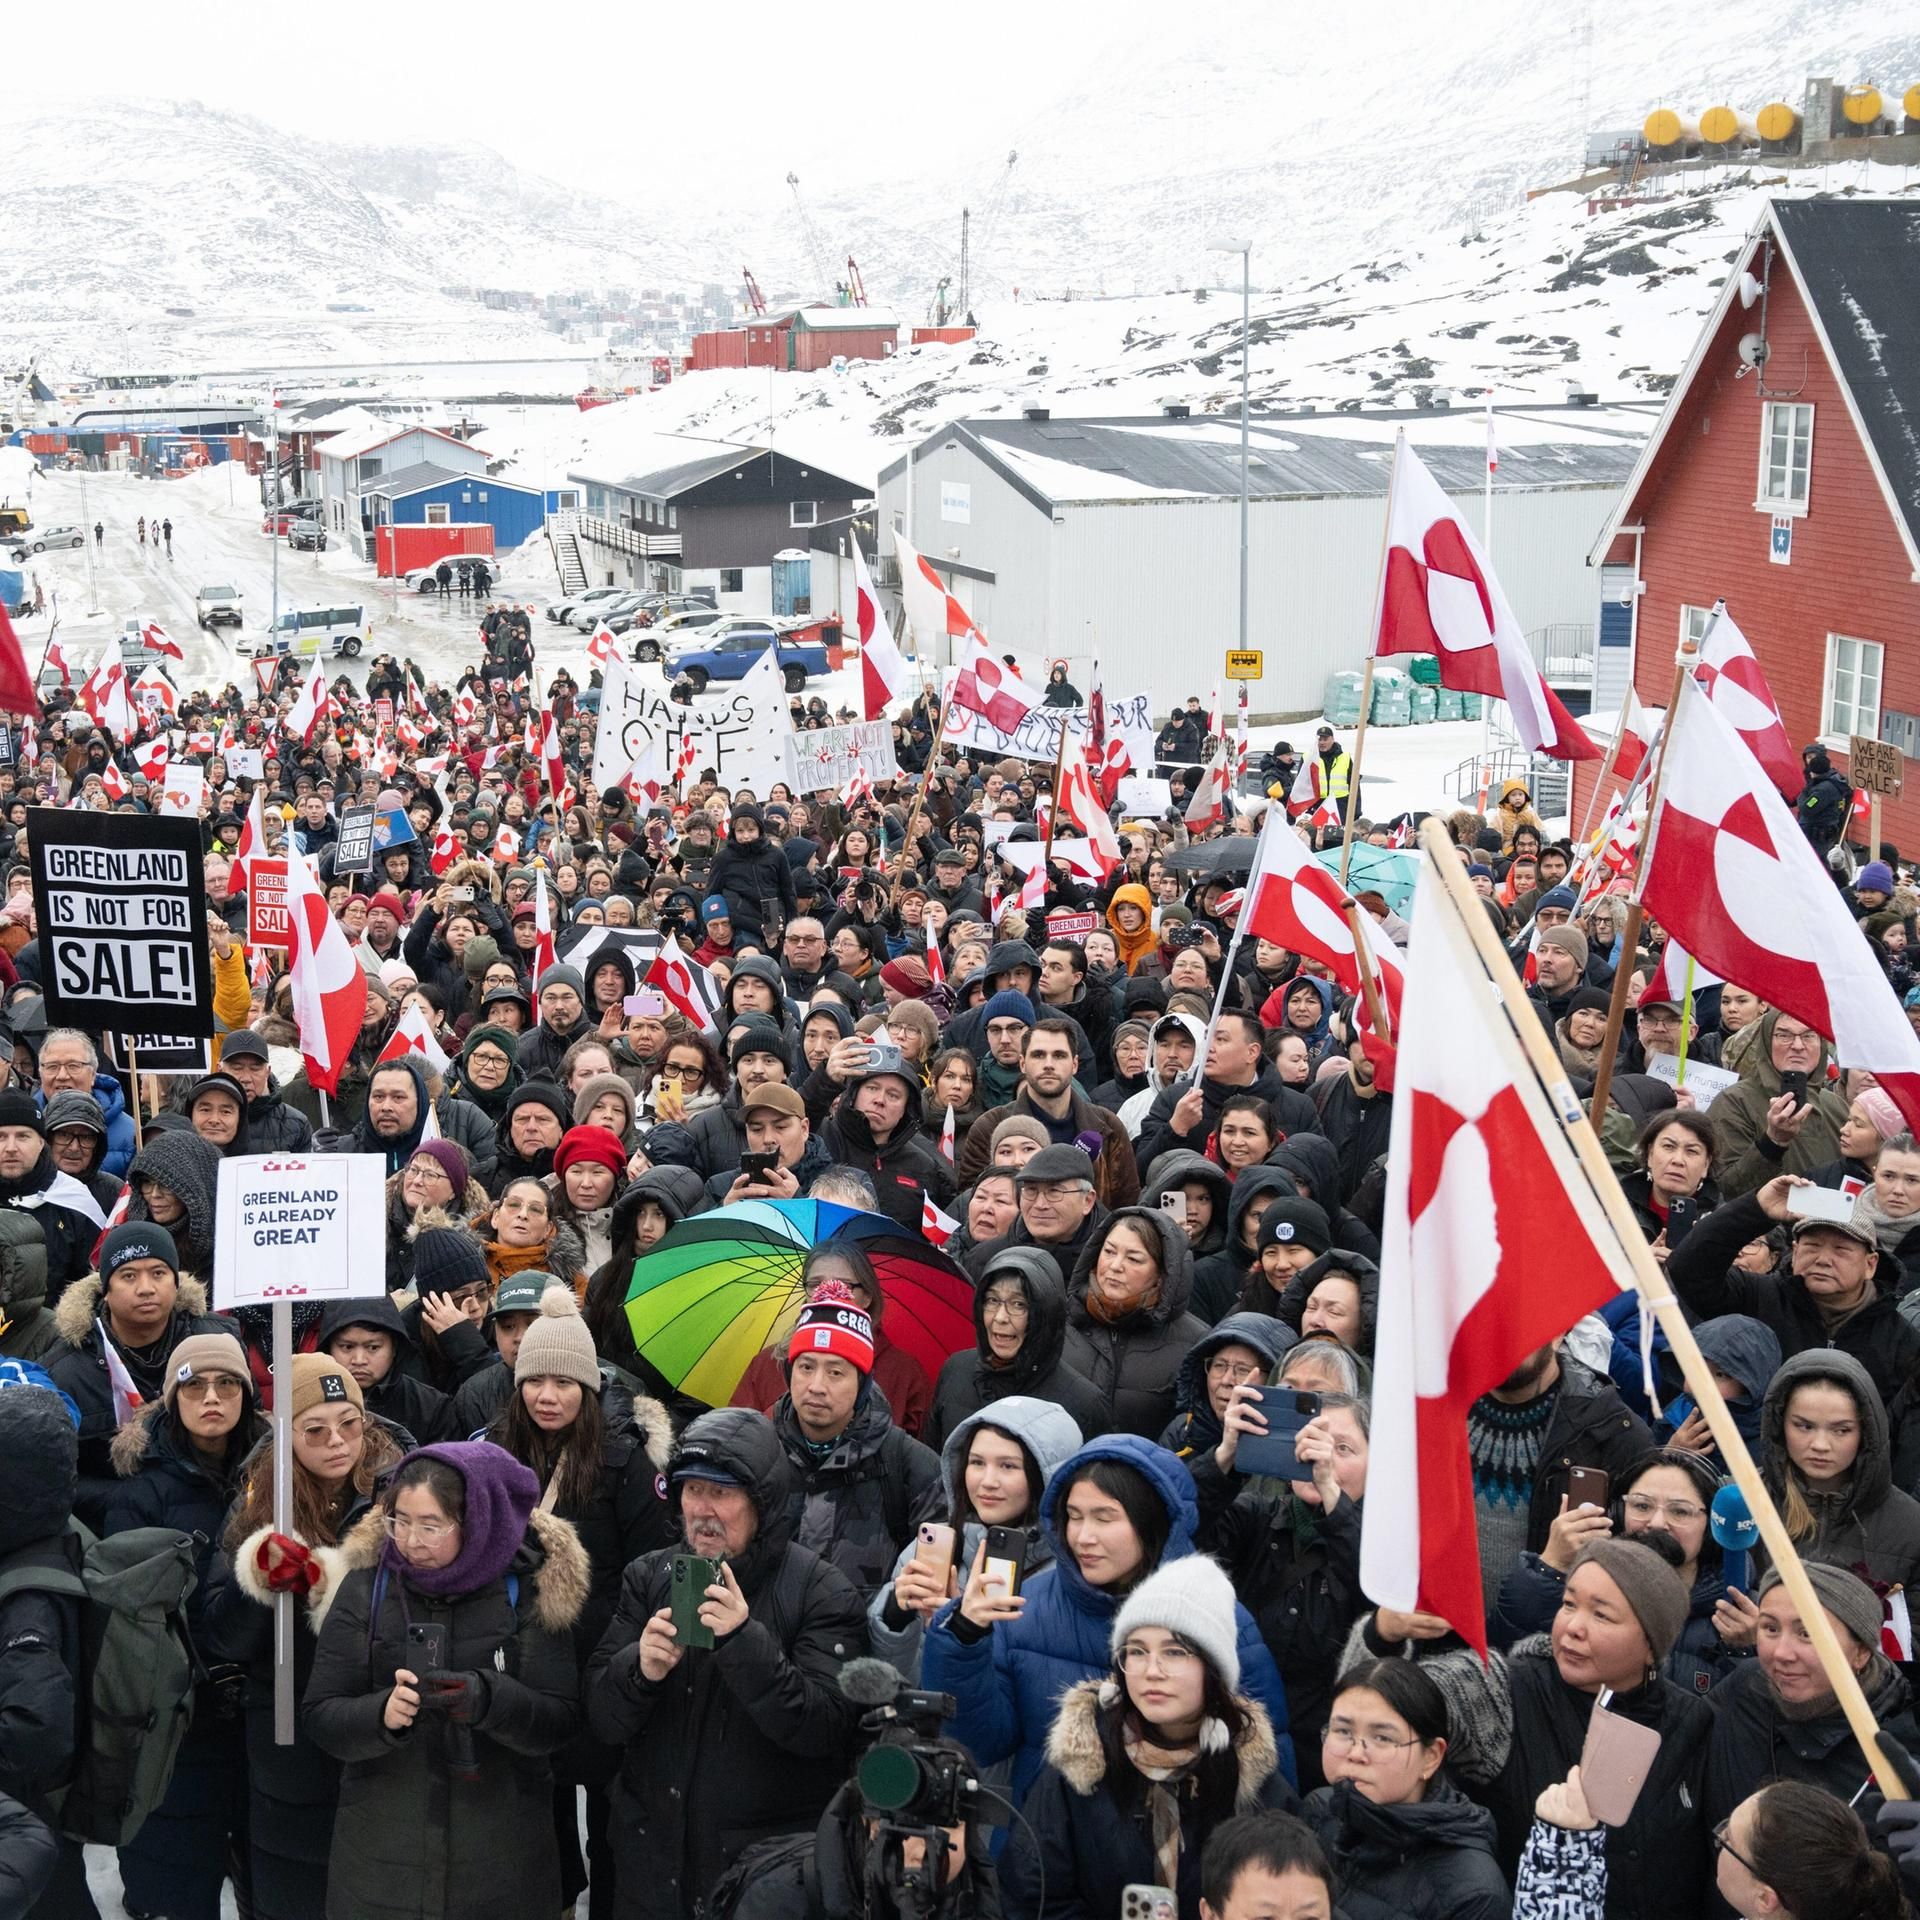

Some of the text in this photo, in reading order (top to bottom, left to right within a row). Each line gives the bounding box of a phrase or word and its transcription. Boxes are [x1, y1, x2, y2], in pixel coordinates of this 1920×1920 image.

[792, 723, 885, 758] WE ARE NOT
[973, 711, 1080, 757] FUTUR
[621, 719, 750, 774] OFF
[1855, 737, 1896, 760] WE ARE
[796, 749, 887, 790] PROPERTY!
[1854, 753, 1896, 775] NOT FOR
[345, 815, 372, 827] GREENLAND
[343, 828, 369, 840] IS NOT FOR
[339, 841, 368, 860] SALE!
[49, 849, 184, 882] GREENLAND
[257, 875, 288, 888] GREENL
[257, 892, 285, 904] IS NOT
[53, 895, 187, 927] IS NOT FOR
[257, 908, 289, 931] SAL
[1050, 917, 1091, 932] GREENLAND
[58, 941, 192, 1001] SALE!
[1654, 1063, 1692, 1081] Kalaalit
[243, 1190, 339, 1207] GREENLAND
[244, 1208, 337, 1225] IS ALREADY
[253, 1228, 321, 1247] GREAT
